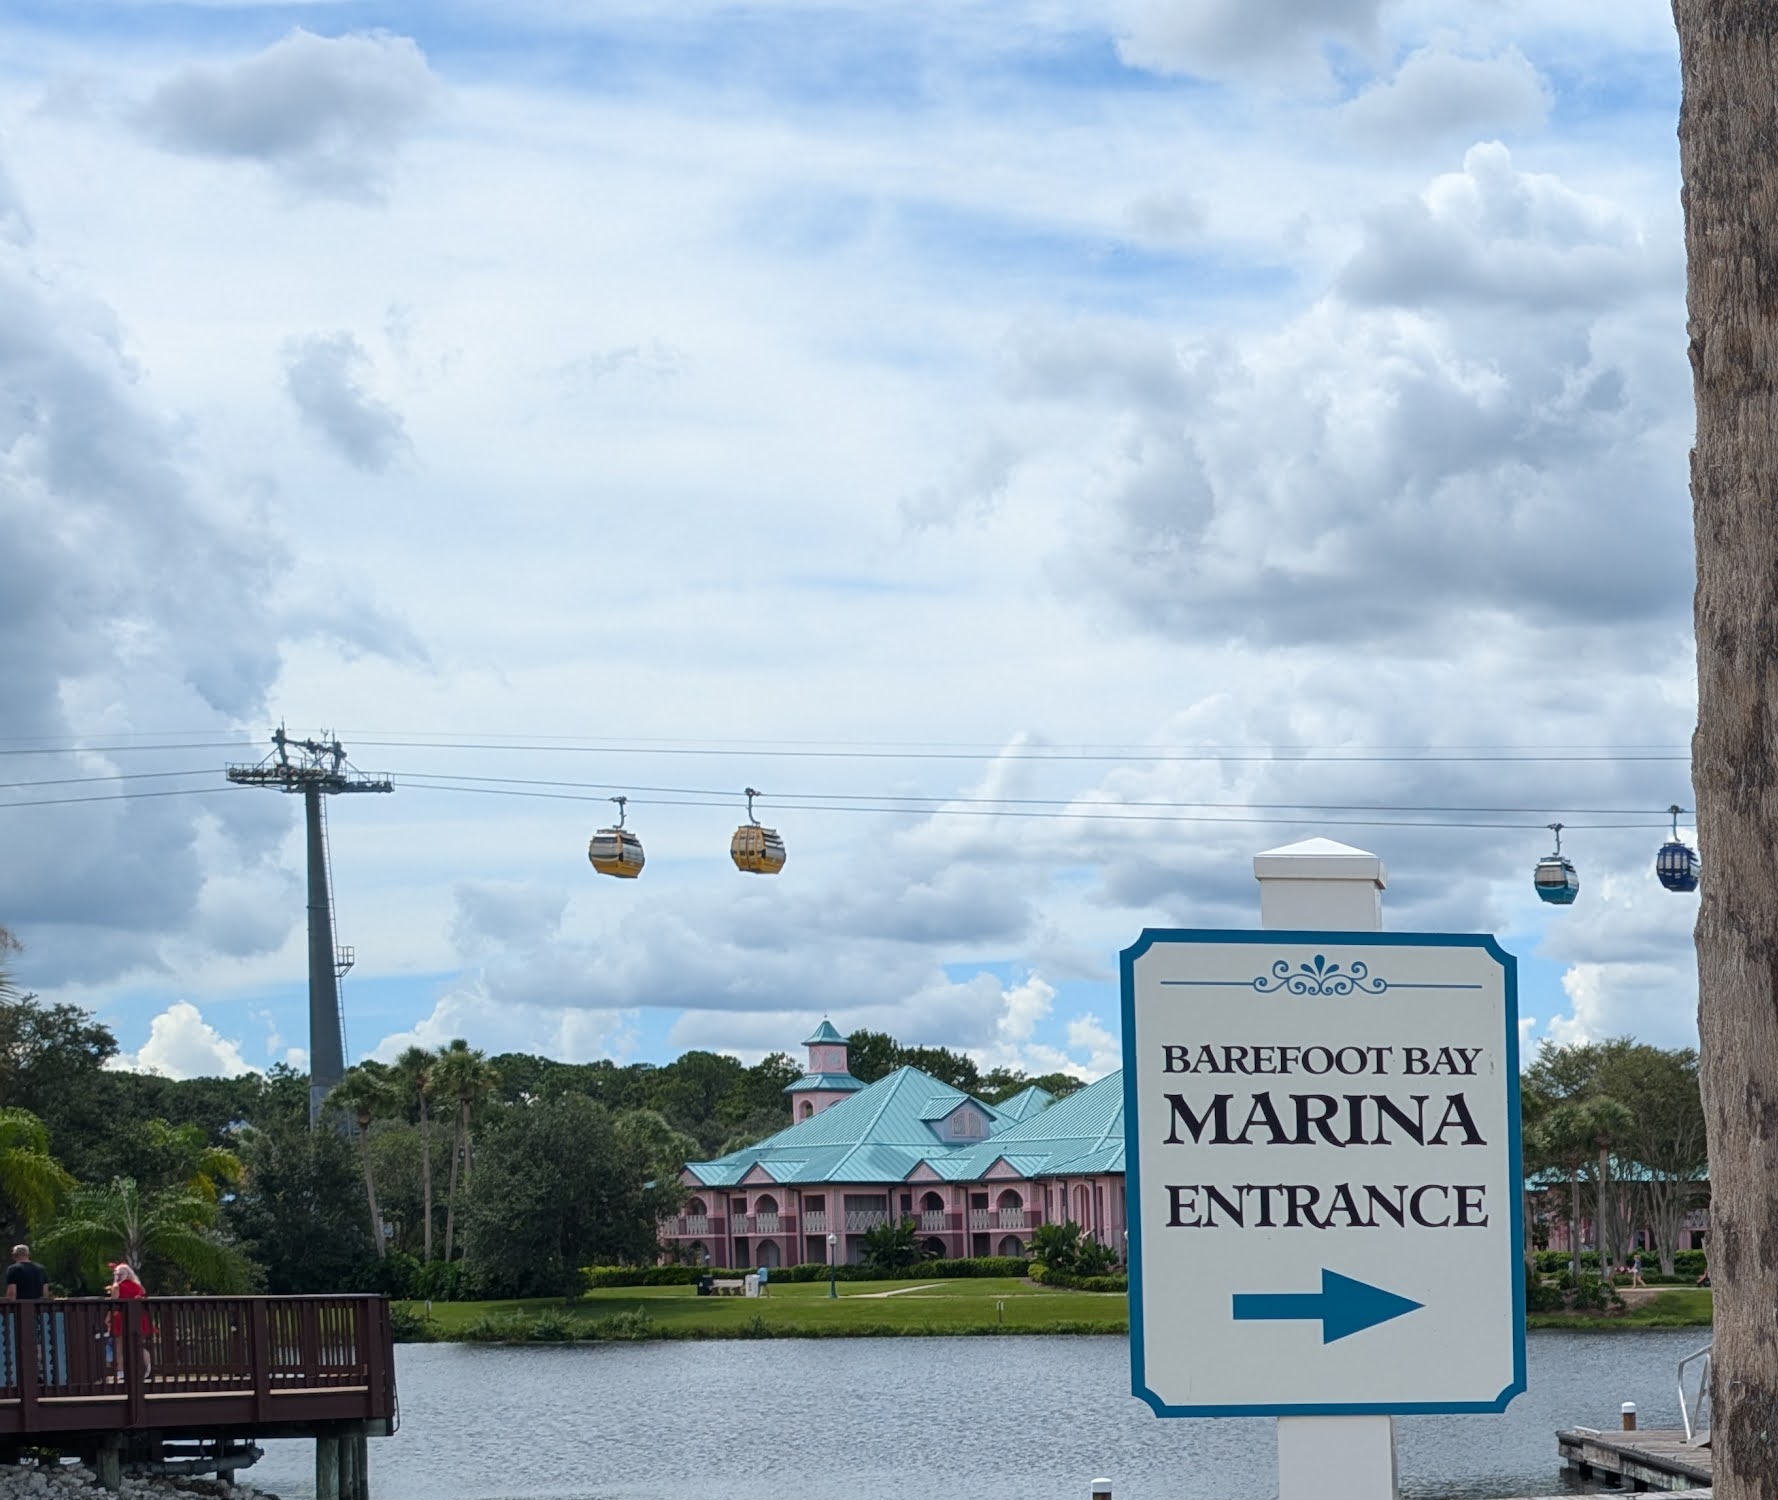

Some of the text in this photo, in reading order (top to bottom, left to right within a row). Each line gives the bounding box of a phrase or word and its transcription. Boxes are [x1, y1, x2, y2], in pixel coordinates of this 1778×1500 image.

[1162, 1044, 1484, 1076] BAREFOOT BAY
[1163, 1091, 1488, 1148] MARINA
[1165, 1183, 1489, 1230] ENTRANCE
